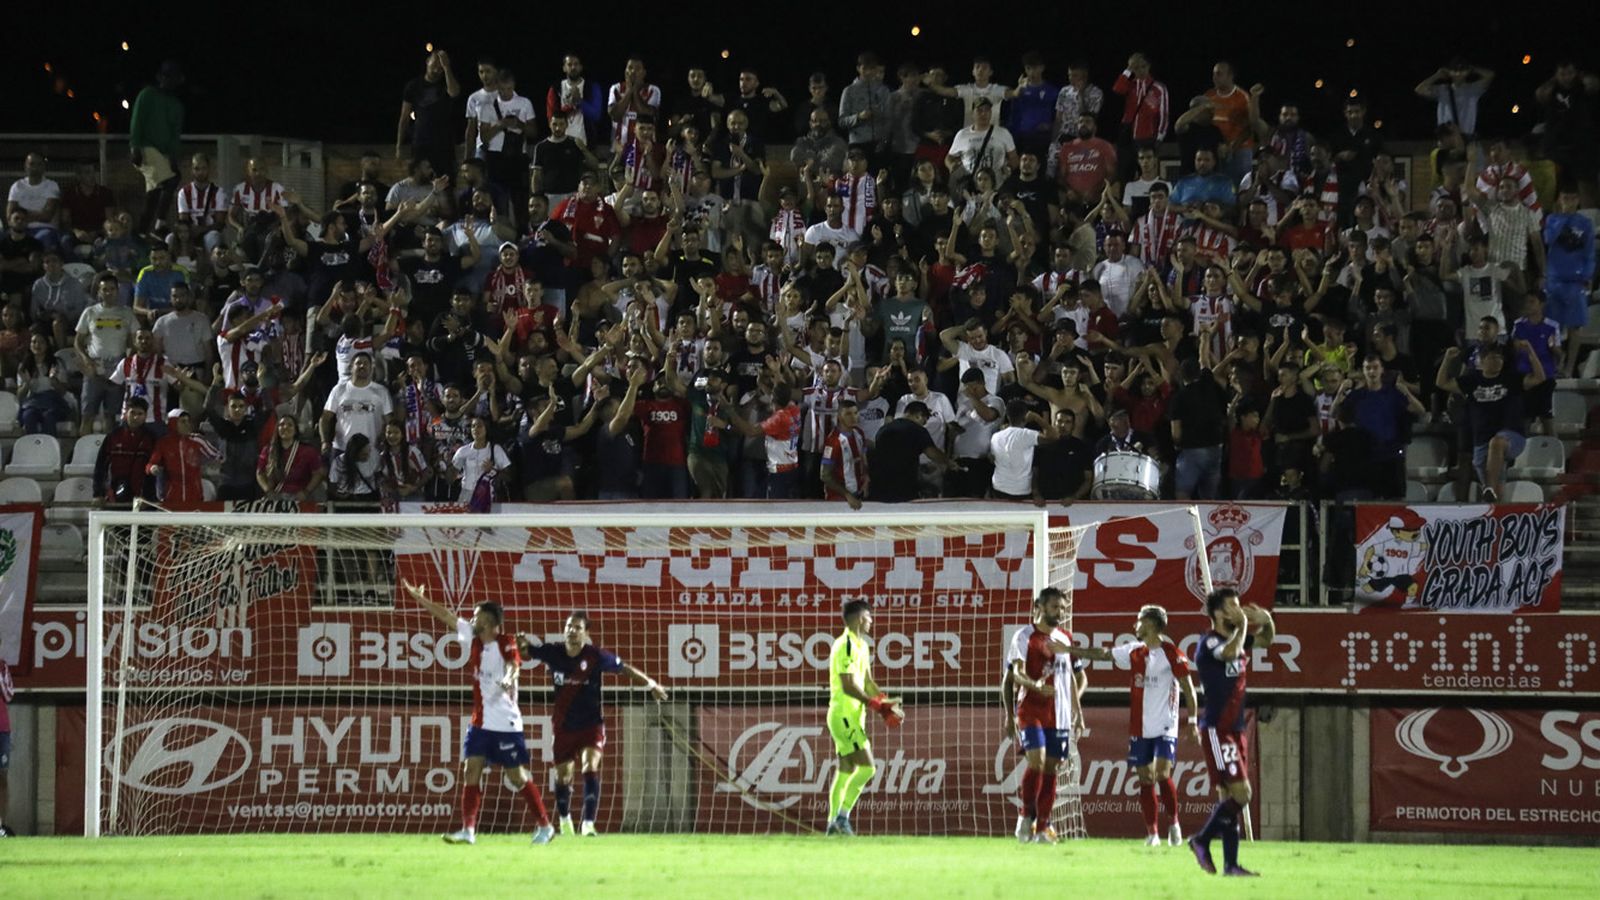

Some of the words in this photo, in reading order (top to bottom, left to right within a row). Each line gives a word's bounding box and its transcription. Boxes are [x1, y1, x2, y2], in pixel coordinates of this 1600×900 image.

[650, 410, 678, 421] 1909
[1424, 517, 1496, 572] YOUTH
[1499, 508, 1560, 562] BOYS
[1421, 566, 1503, 608] GRADA
[1505, 555, 1557, 606] ACF
[679, 592, 763, 606] GRADA
[777, 593, 827, 607] ACF
[936, 594, 985, 608] SUR
[729, 632, 962, 669] BESOCER
[220, 669, 251, 681] ver
[1422, 673, 1542, 688] tendencias
[1221, 743, 1240, 763] 22
[227, 801, 451, 821] ventas@permotor.com
[1396, 806, 1481, 821] PERMOTOR
[1486, 808, 1516, 822] DEL
